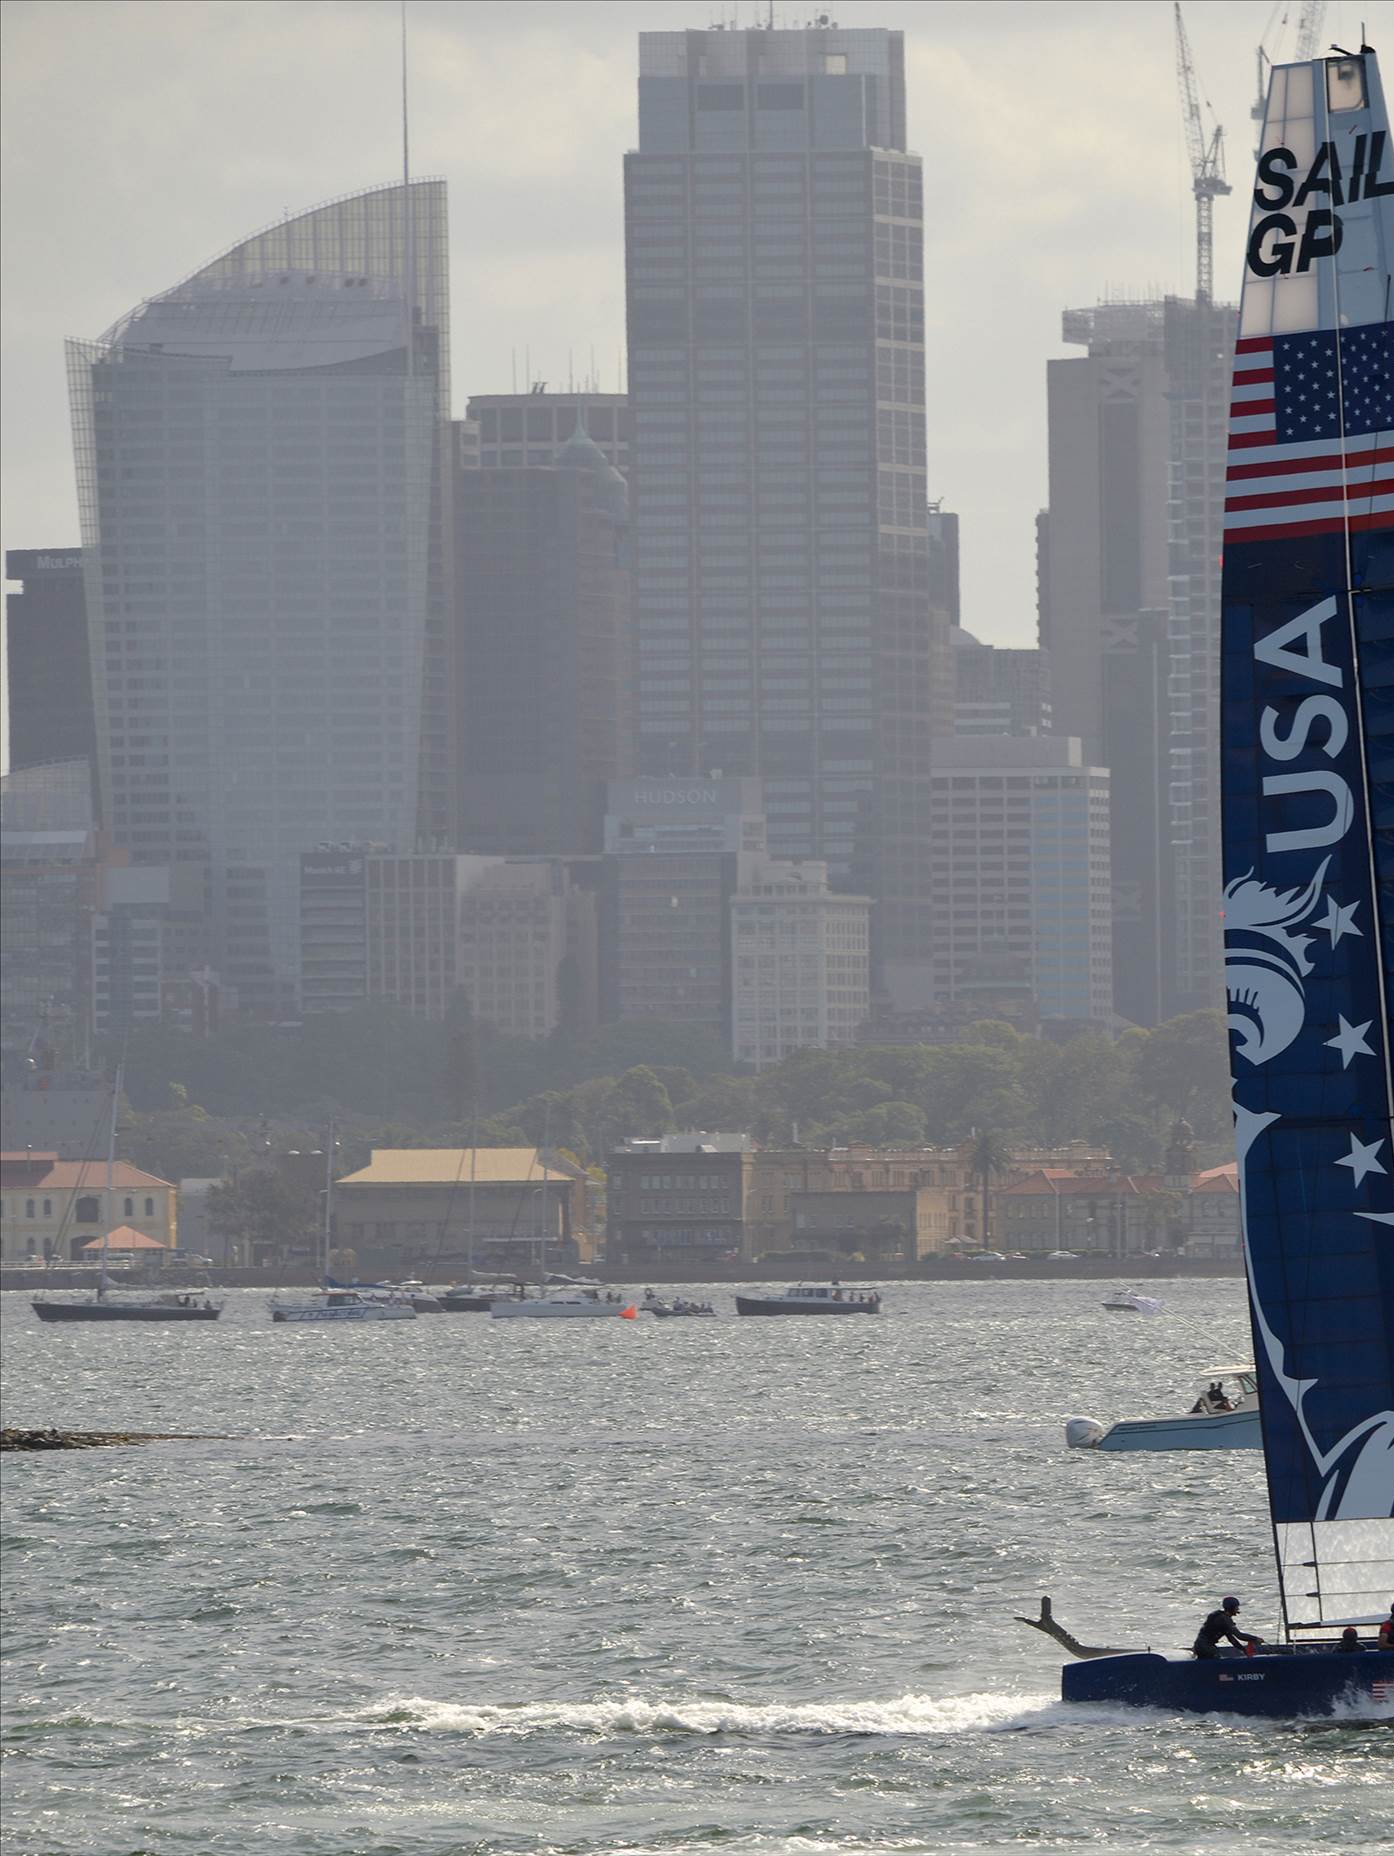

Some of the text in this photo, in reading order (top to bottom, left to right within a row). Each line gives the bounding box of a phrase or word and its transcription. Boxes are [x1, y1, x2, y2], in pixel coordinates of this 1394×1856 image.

[1246, 209, 1344, 277] GP
[1254, 594, 1354, 853] USA
[635, 789, 717, 804] HUDSON
[1237, 1673, 1265, 1681] KIRBY
